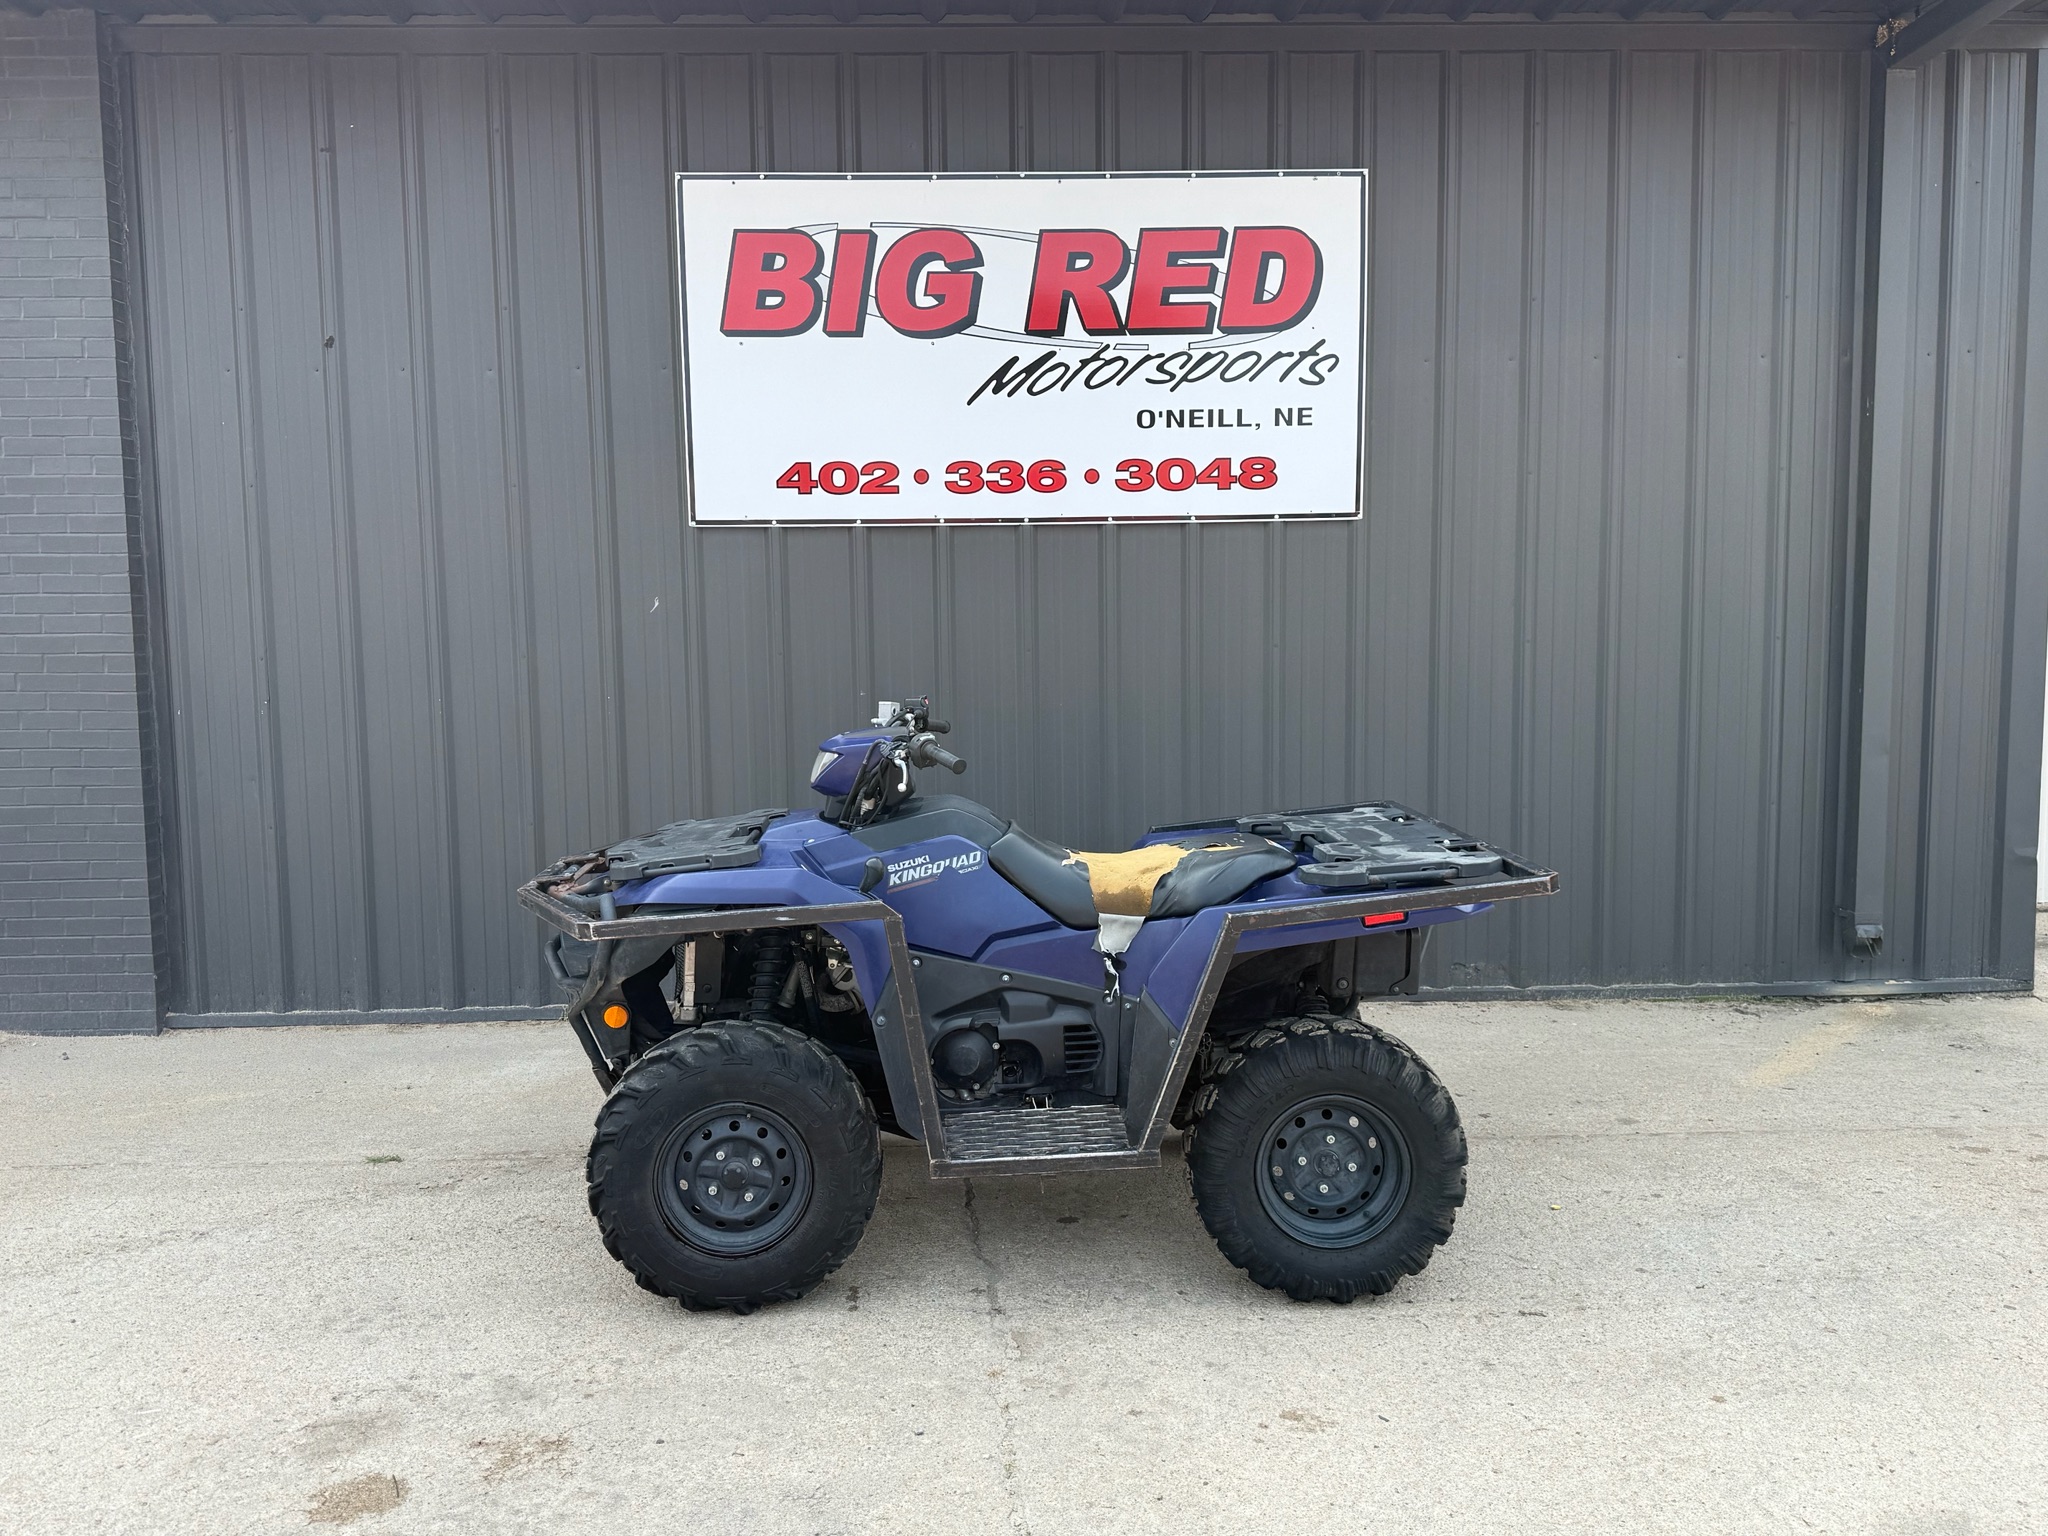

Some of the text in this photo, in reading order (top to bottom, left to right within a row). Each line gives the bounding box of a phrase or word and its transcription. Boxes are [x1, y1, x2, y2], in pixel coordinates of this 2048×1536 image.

[720, 225, 1324, 339] BIG RED
[966, 338, 1341, 406] Motorsports
[1135, 406, 1314, 431] O'NEILL, NE
[775, 456, 1278, 495] 402 336 3048
[887, 854, 930, 873] SUZUKI
[1235, 1084, 1294, 1159] CARLSTAR
